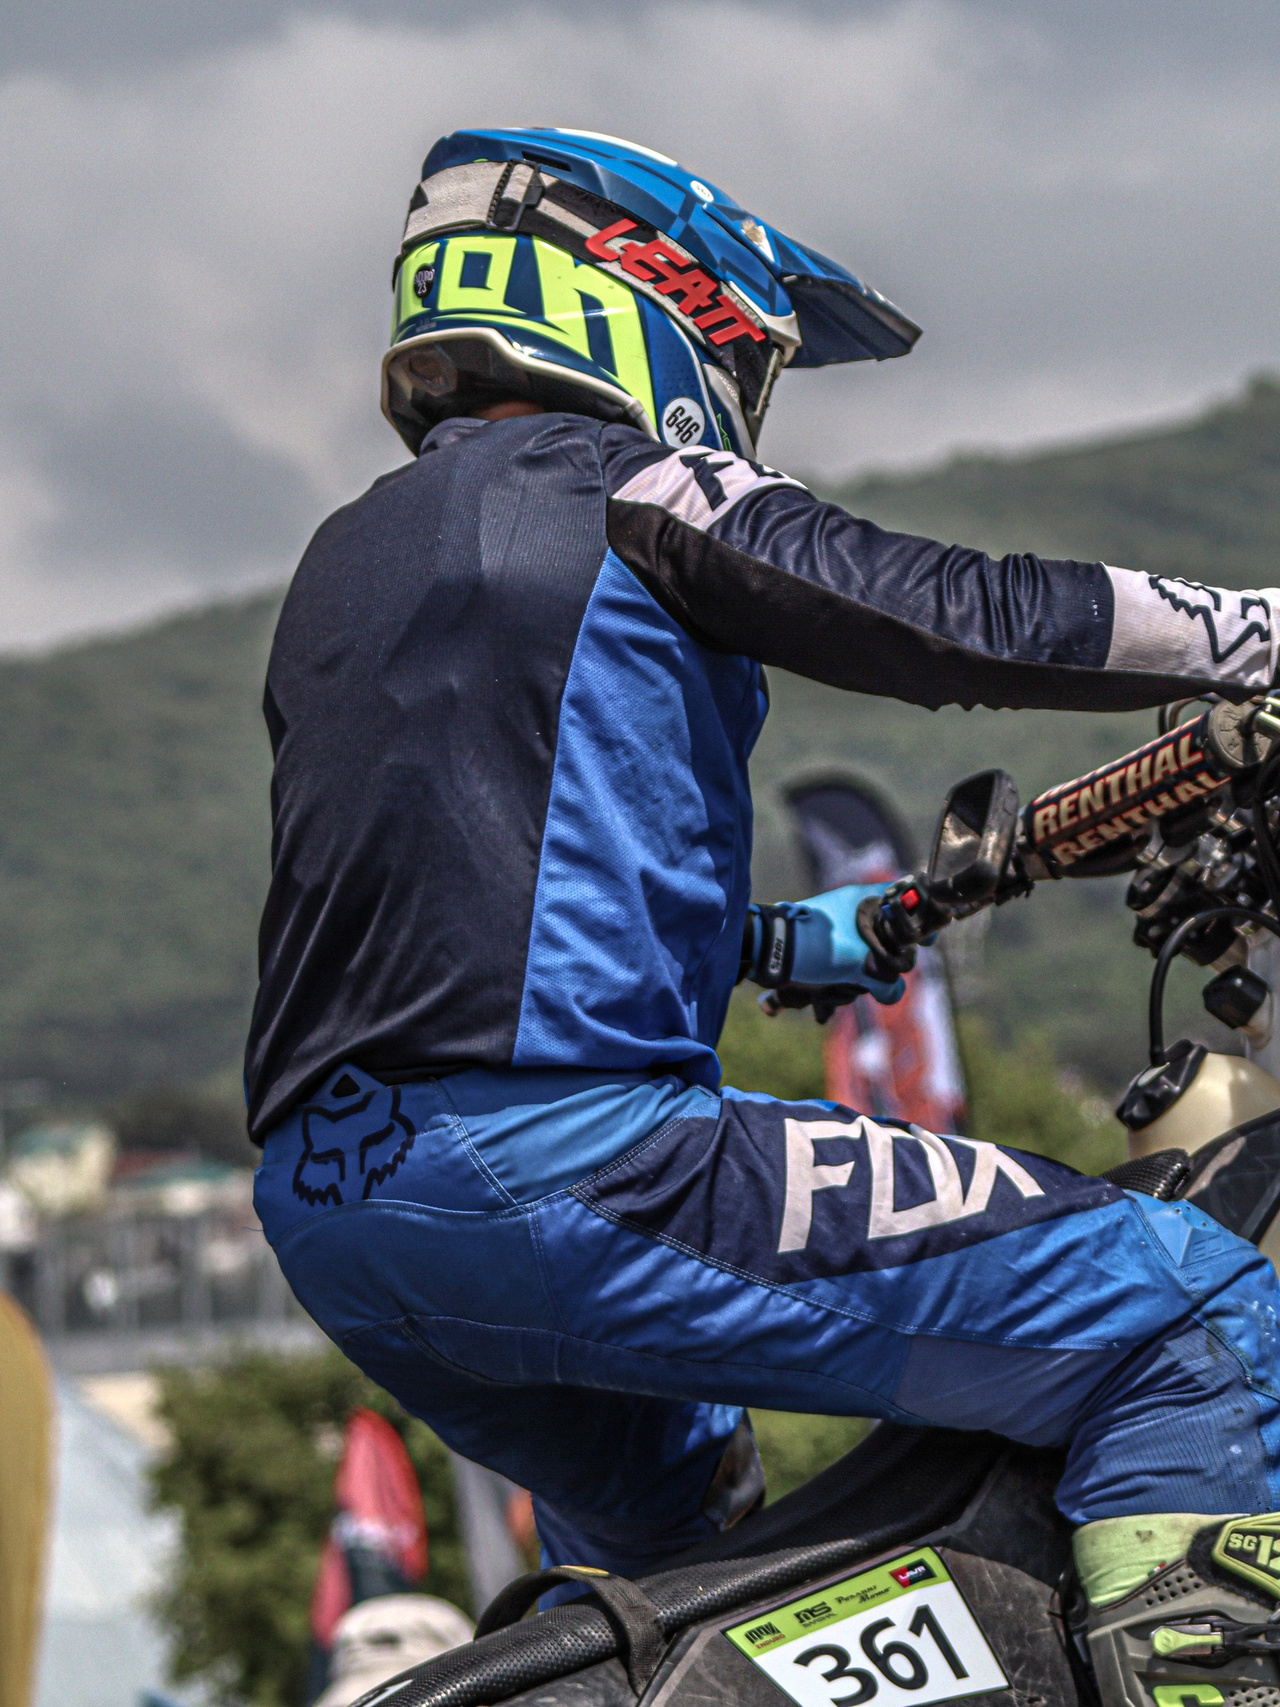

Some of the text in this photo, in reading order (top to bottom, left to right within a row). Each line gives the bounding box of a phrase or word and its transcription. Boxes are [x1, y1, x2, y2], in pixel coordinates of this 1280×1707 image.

[417, 280, 428, 295] 23
[664, 407, 701, 445] 646
[1031, 732, 1204, 846] RENTHAL
[1051, 771, 1232, 867] RENTHAL
[769, 937, 784, 974] 100%
[777, 1115, 1046, 1254] FOX
[898, 1563, 926, 1580] LAVR
[755, 1632, 786, 1650] ENDURO
[793, 1604, 969, 1707] 361
